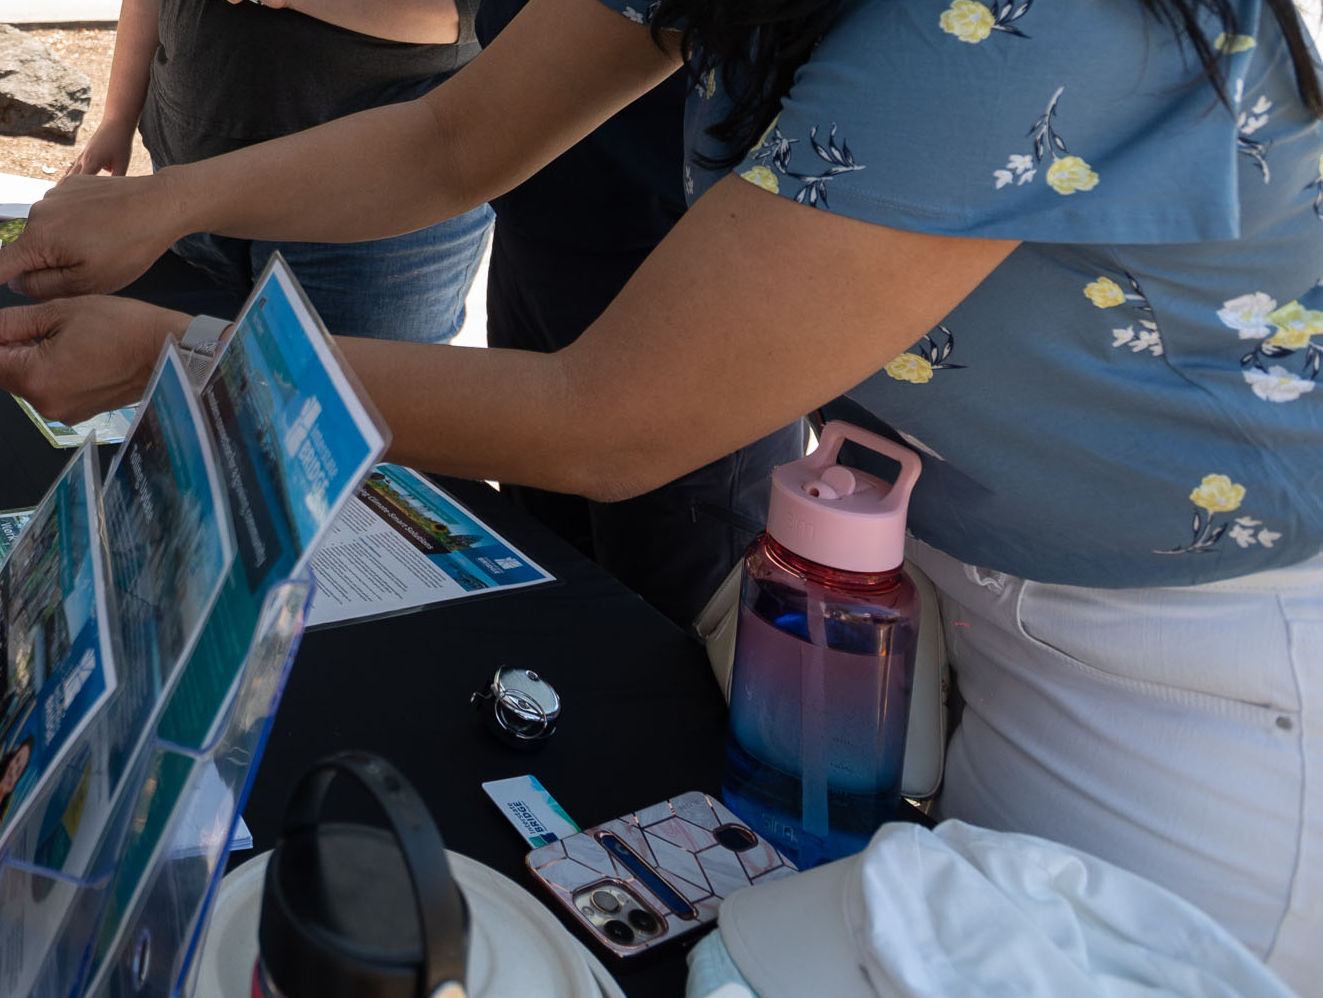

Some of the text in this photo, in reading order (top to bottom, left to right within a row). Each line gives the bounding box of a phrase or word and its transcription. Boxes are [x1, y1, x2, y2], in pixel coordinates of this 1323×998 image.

[0, 522, 18, 542] Work
[404, 526, 434, 550] Solutions
[507, 802, 536, 835] Interstate
[513, 800, 544, 833] BRIDGE
